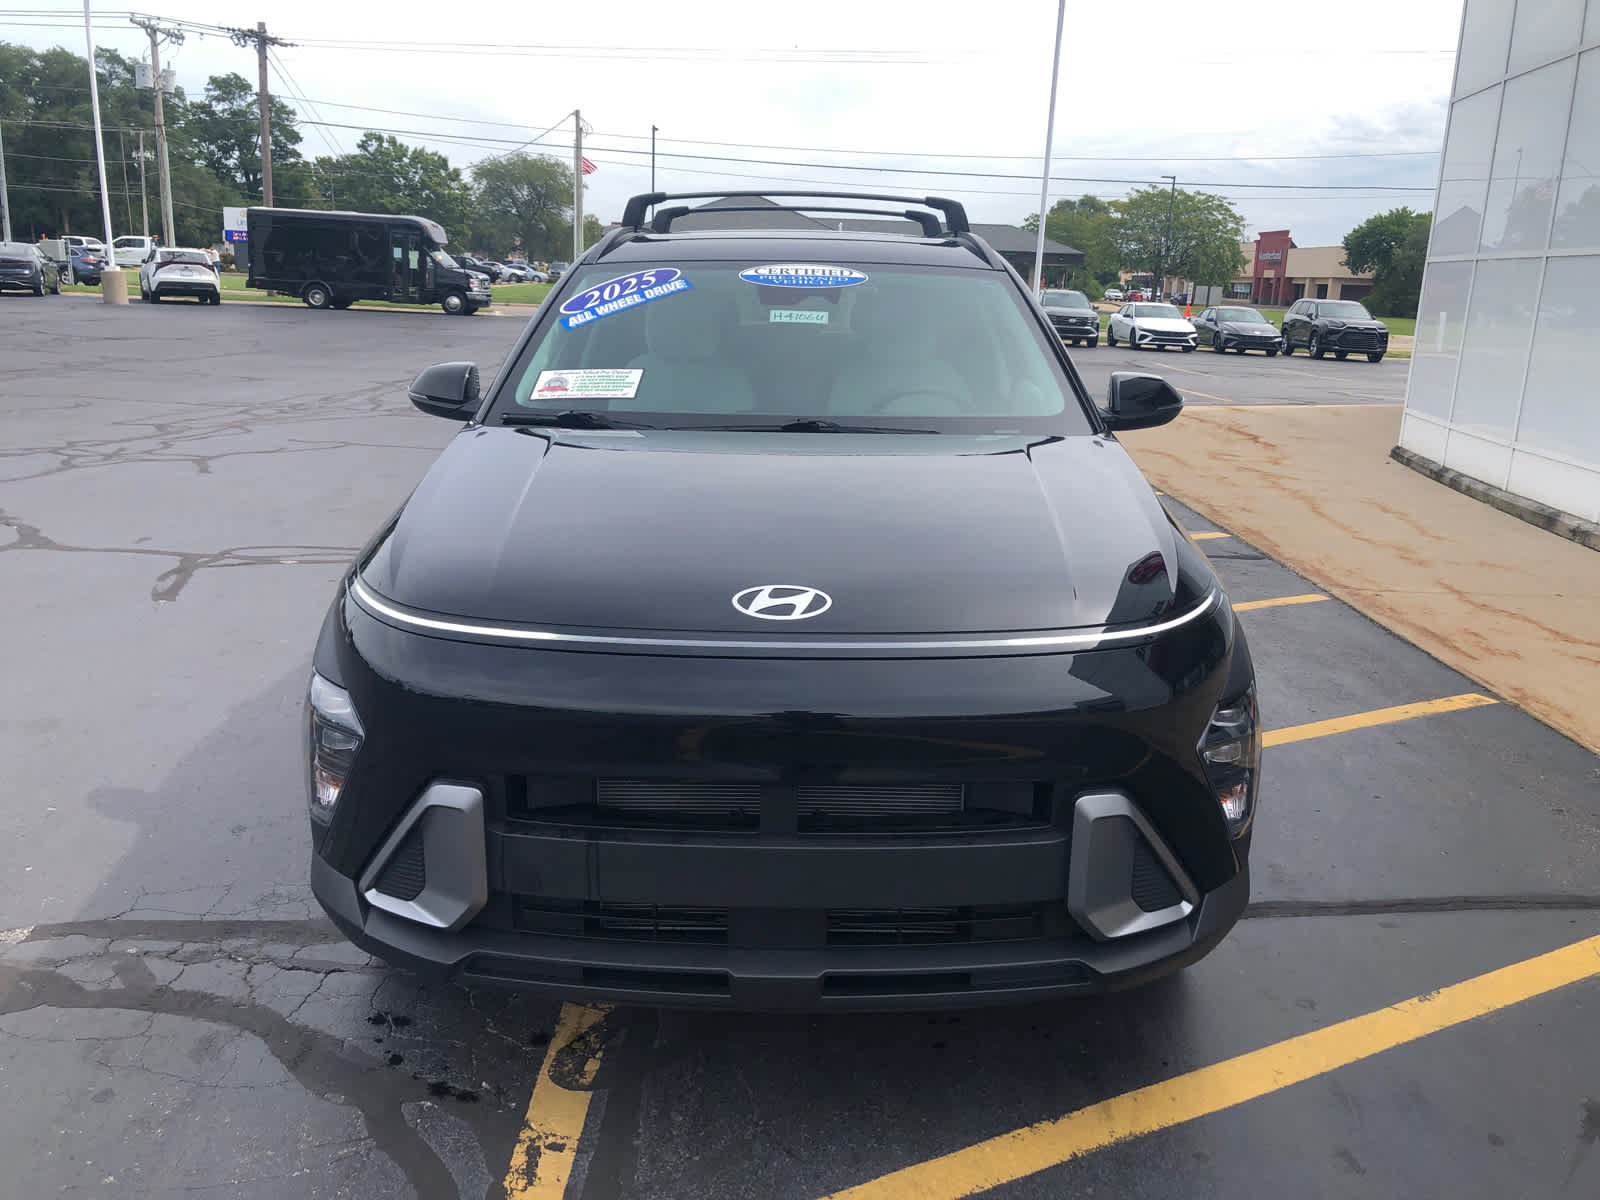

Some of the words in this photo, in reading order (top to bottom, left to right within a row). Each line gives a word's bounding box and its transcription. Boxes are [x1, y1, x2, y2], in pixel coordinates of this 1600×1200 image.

[584, 271, 656, 309] 2025
[754, 267, 853, 276] CERTIFIED
[568, 311, 597, 327] ALL
[594, 293, 646, 315] WHEEL
[643, 279, 688, 299] DRIVE
